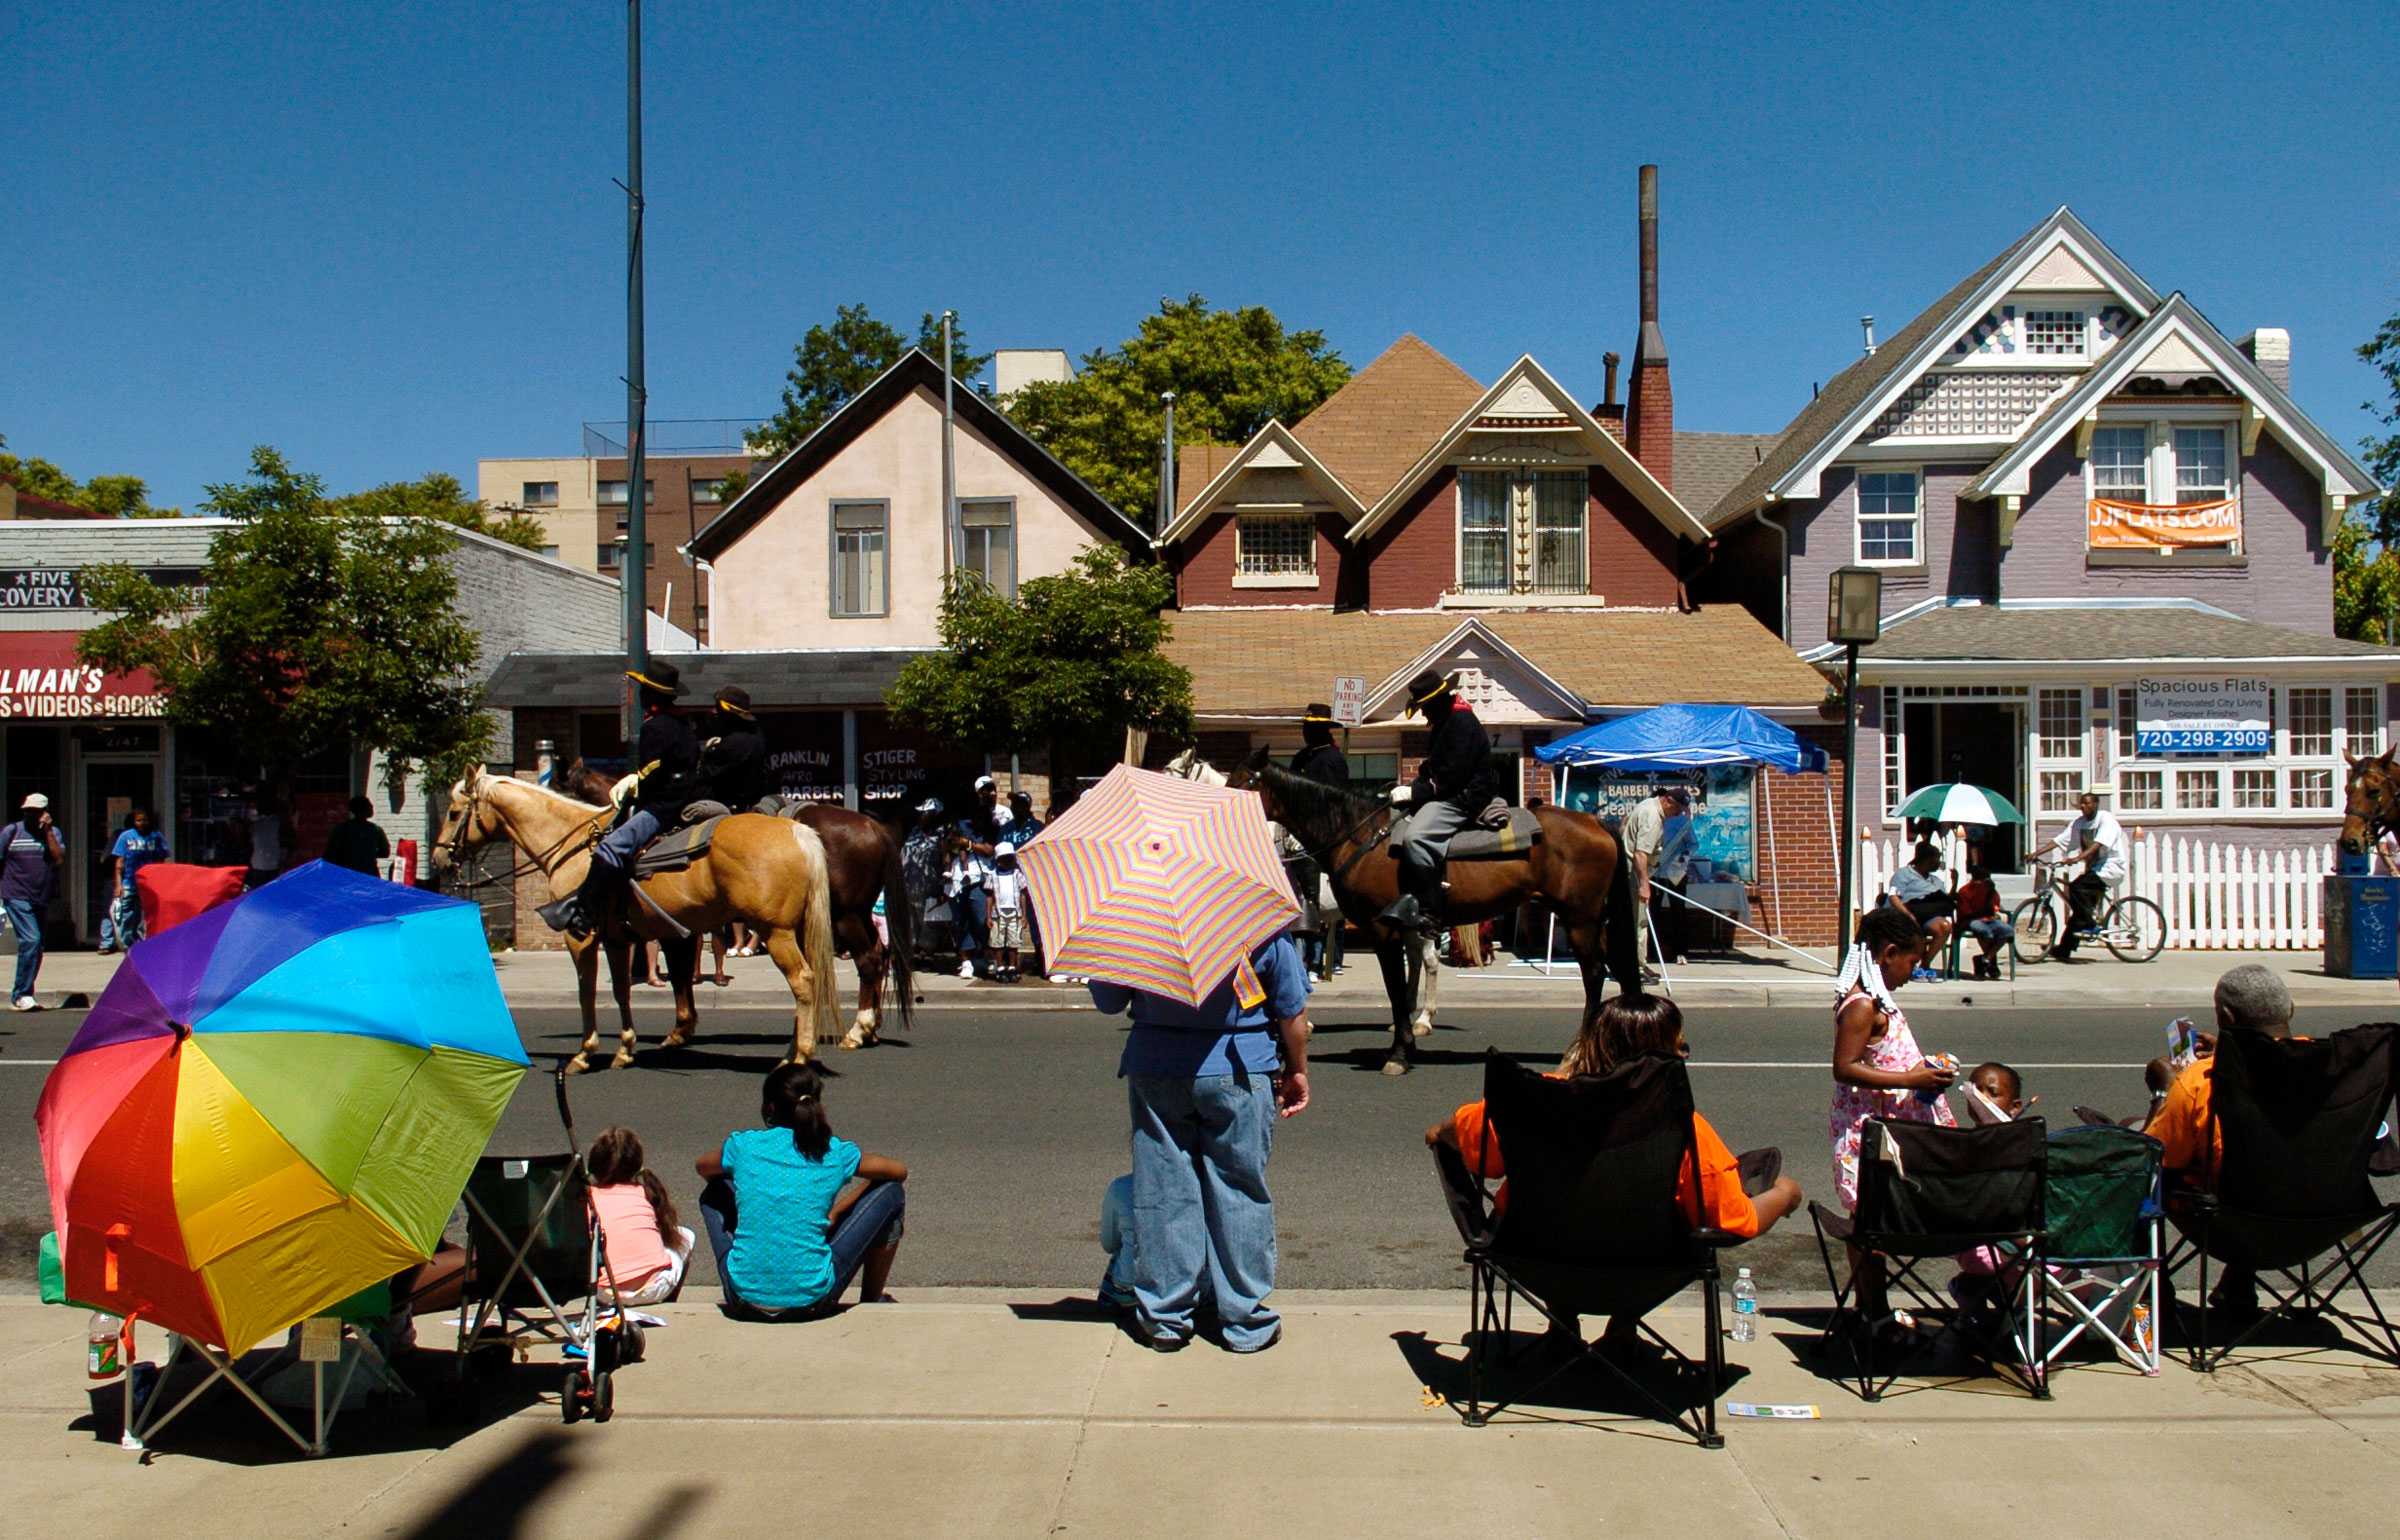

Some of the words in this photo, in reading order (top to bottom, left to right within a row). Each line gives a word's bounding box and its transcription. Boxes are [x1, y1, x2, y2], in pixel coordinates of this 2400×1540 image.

[2090, 504, 2235, 528] JJFLATS.COM
[31, 571, 71, 586] FIVE
[0, 664, 104, 693] LMAN'S
[1343, 679, 1355, 691] NO
[2140, 679, 2219, 695] Spacious
[2225, 679, 2267, 692] Flats
[1336, 691, 1361, 703] PARKING
[2144, 699, 2165, 709] Fully
[2168, 699, 2213, 708] Renovated
[2216, 698, 2234, 709] City
[2236, 698, 2263, 710] Living
[24, 695, 93, 717] VIDEOS
[2168, 710, 2204, 719] Designer
[2207, 710, 2240, 718] Finishes
[2139, 731, 2267, 747] 720-298-2909
[769, 751, 831, 770] RANKLIN
[863, 750, 917, 769] STIGER
[782, 769, 813, 783] AFRO
[868, 768, 926, 782] STYLING
[781, 785, 844, 801] BARBER
[864, 784, 908, 800] SHOP
[1608, 784, 1649, 797] BARBER
